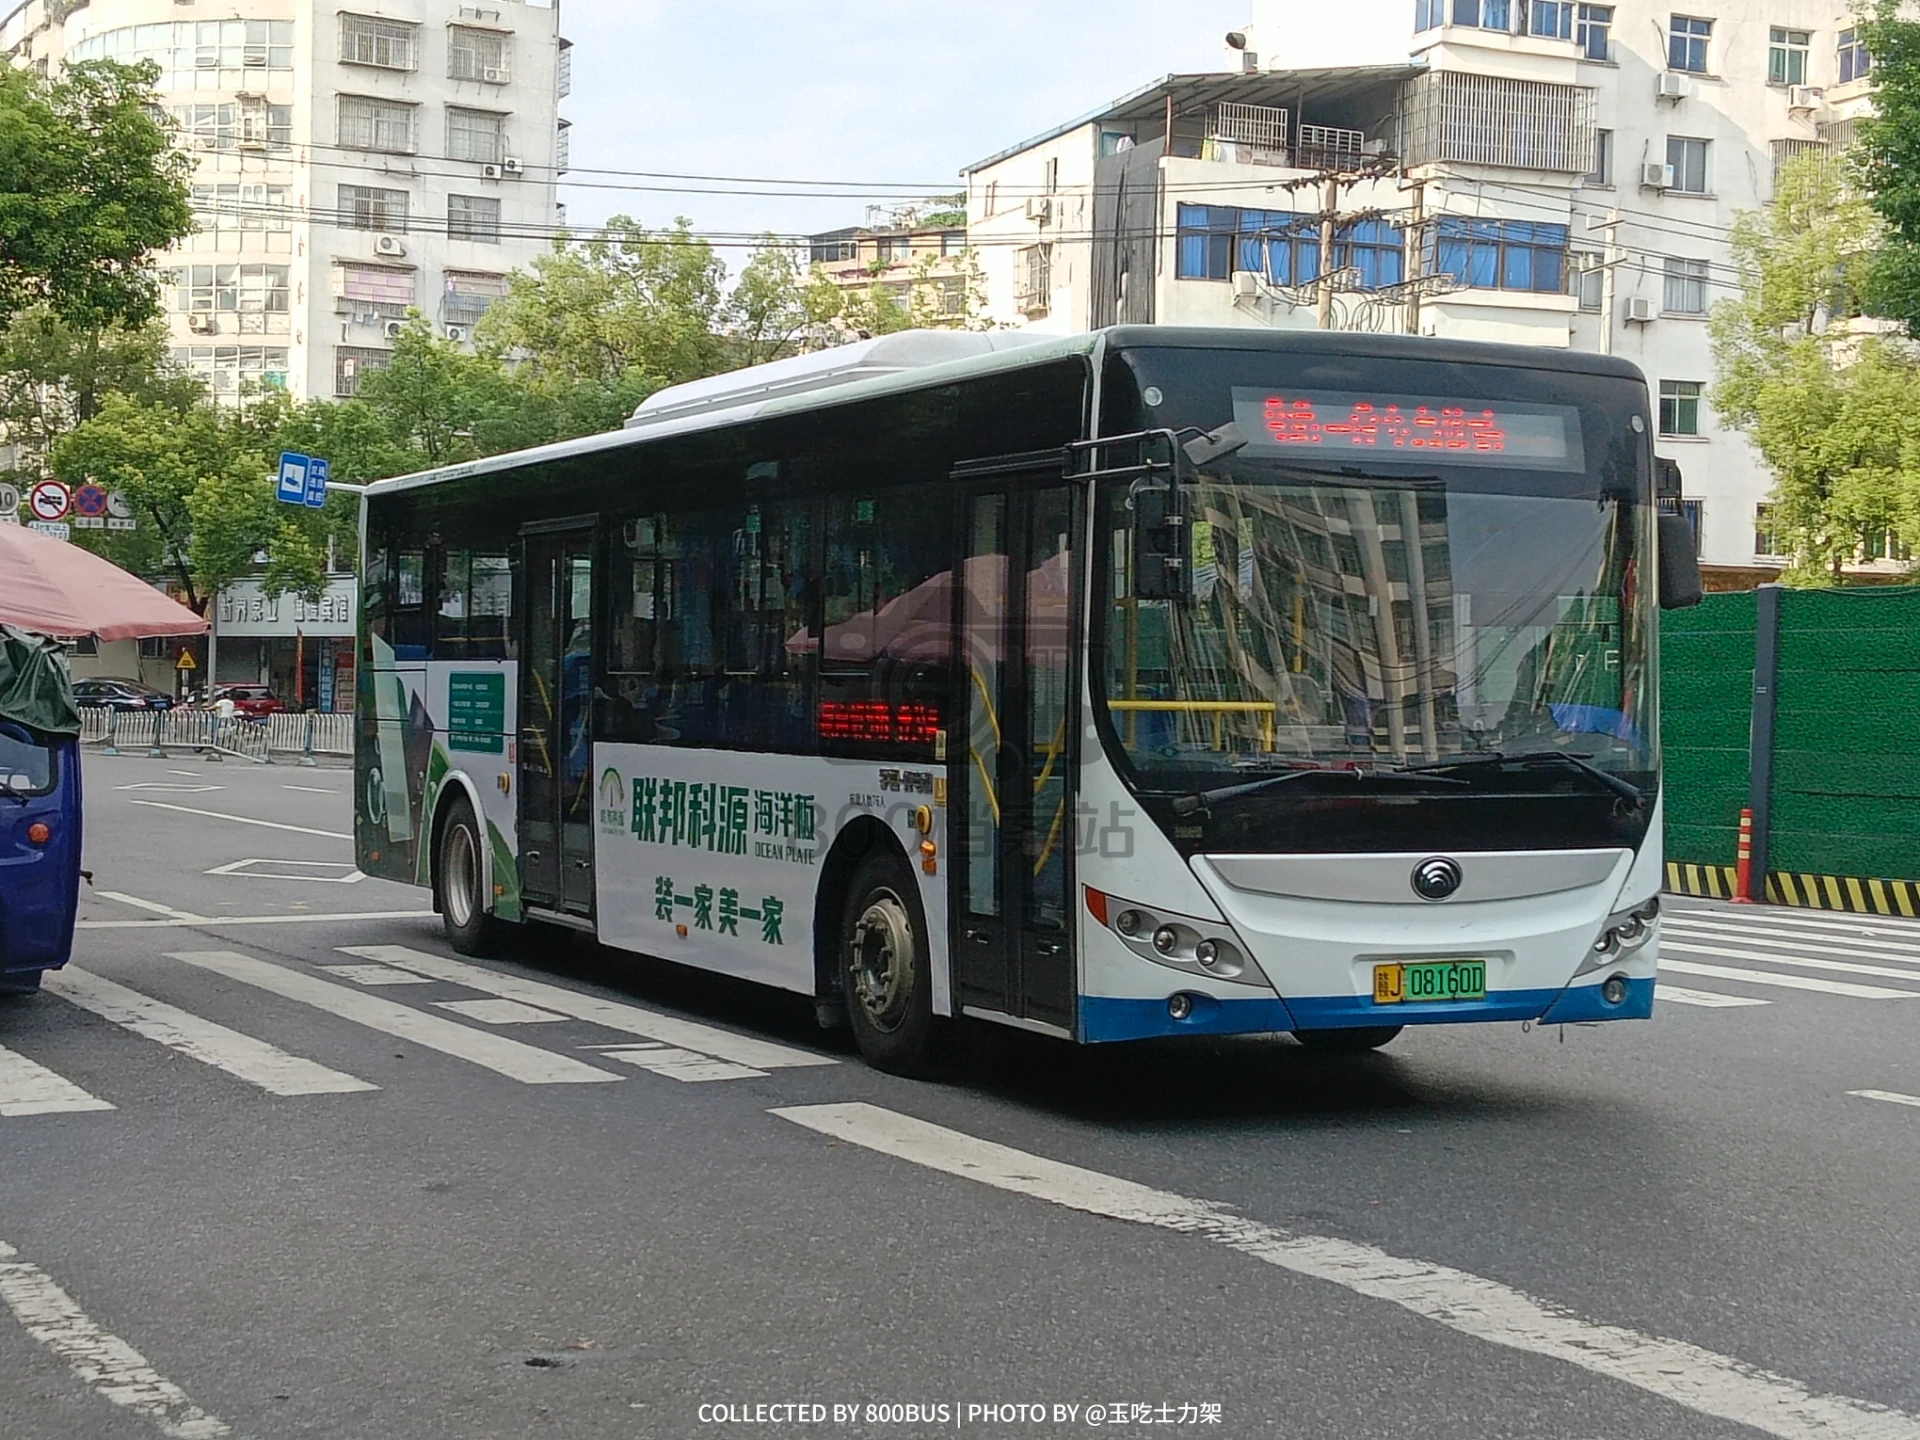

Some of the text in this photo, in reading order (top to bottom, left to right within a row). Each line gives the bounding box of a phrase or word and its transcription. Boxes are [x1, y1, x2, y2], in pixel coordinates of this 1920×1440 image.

[0, 491, 13, 507] 0
[631, 776, 749, 855] 联邦科源
[753, 789, 816, 842] 海洋板
[754, 842, 815, 866] OCEAN PLATE
